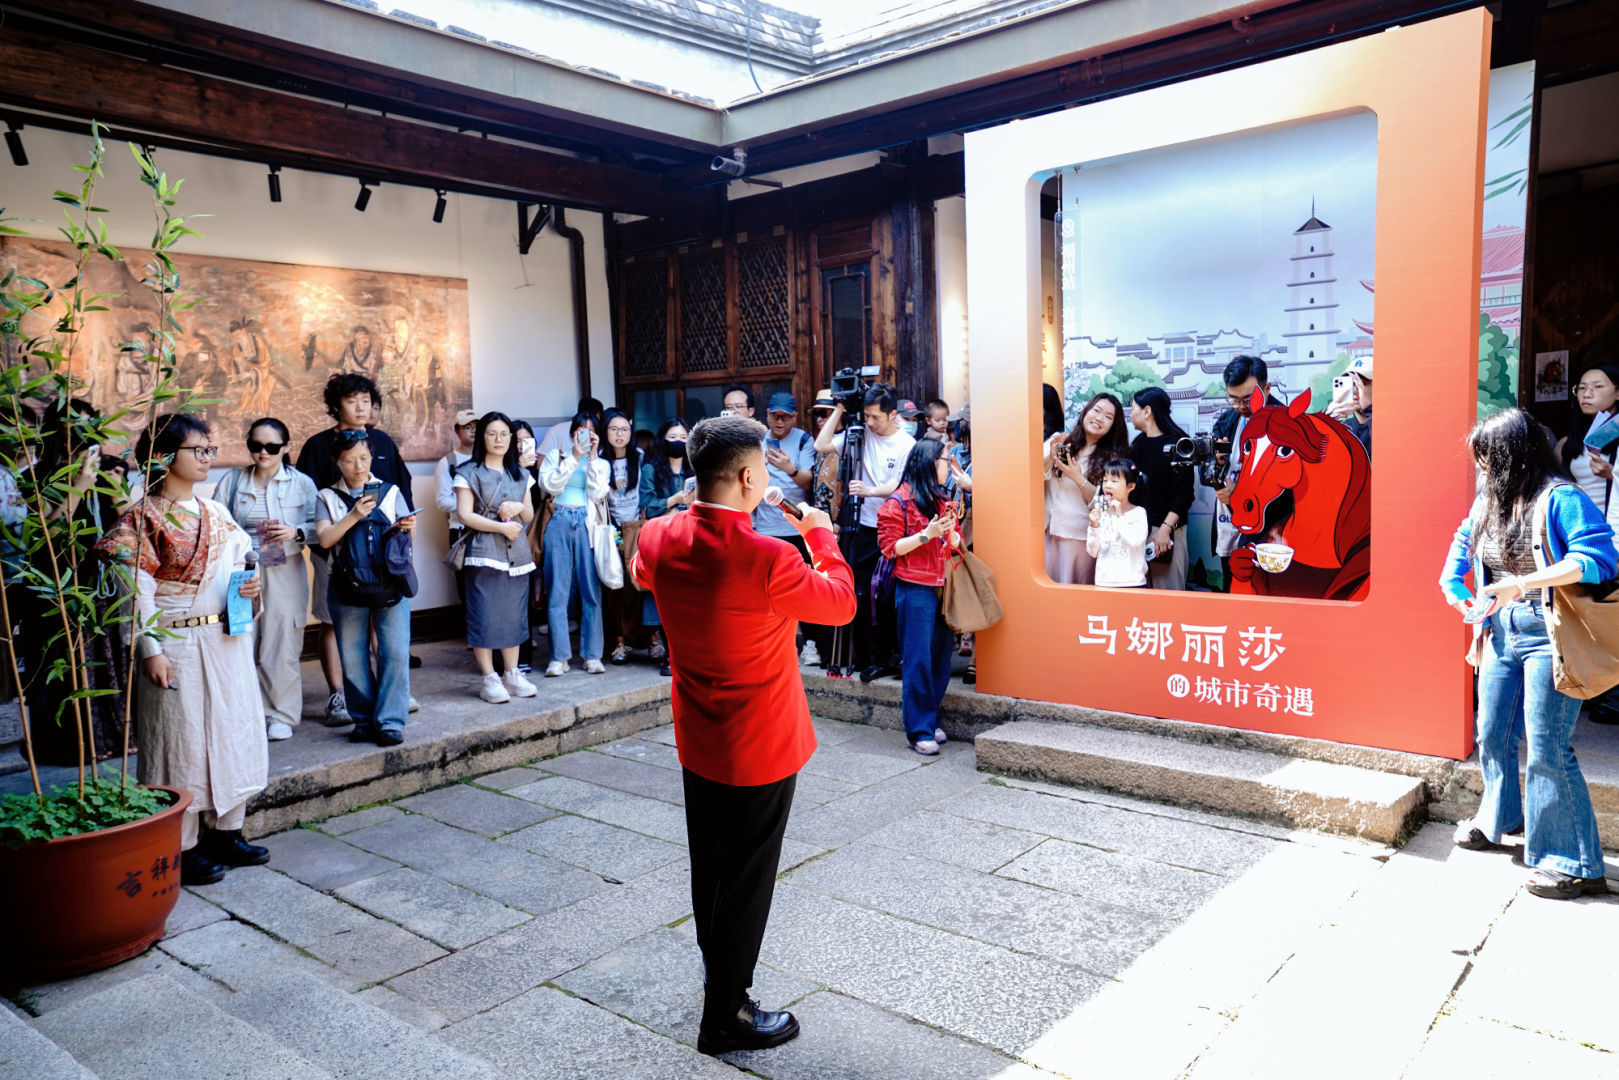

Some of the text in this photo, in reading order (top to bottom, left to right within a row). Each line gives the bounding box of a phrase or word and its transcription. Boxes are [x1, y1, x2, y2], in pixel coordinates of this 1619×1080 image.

[1079, 614, 1286, 672] 马娜丽莎
[1167, 673, 1315, 717] 的城市奇遇
